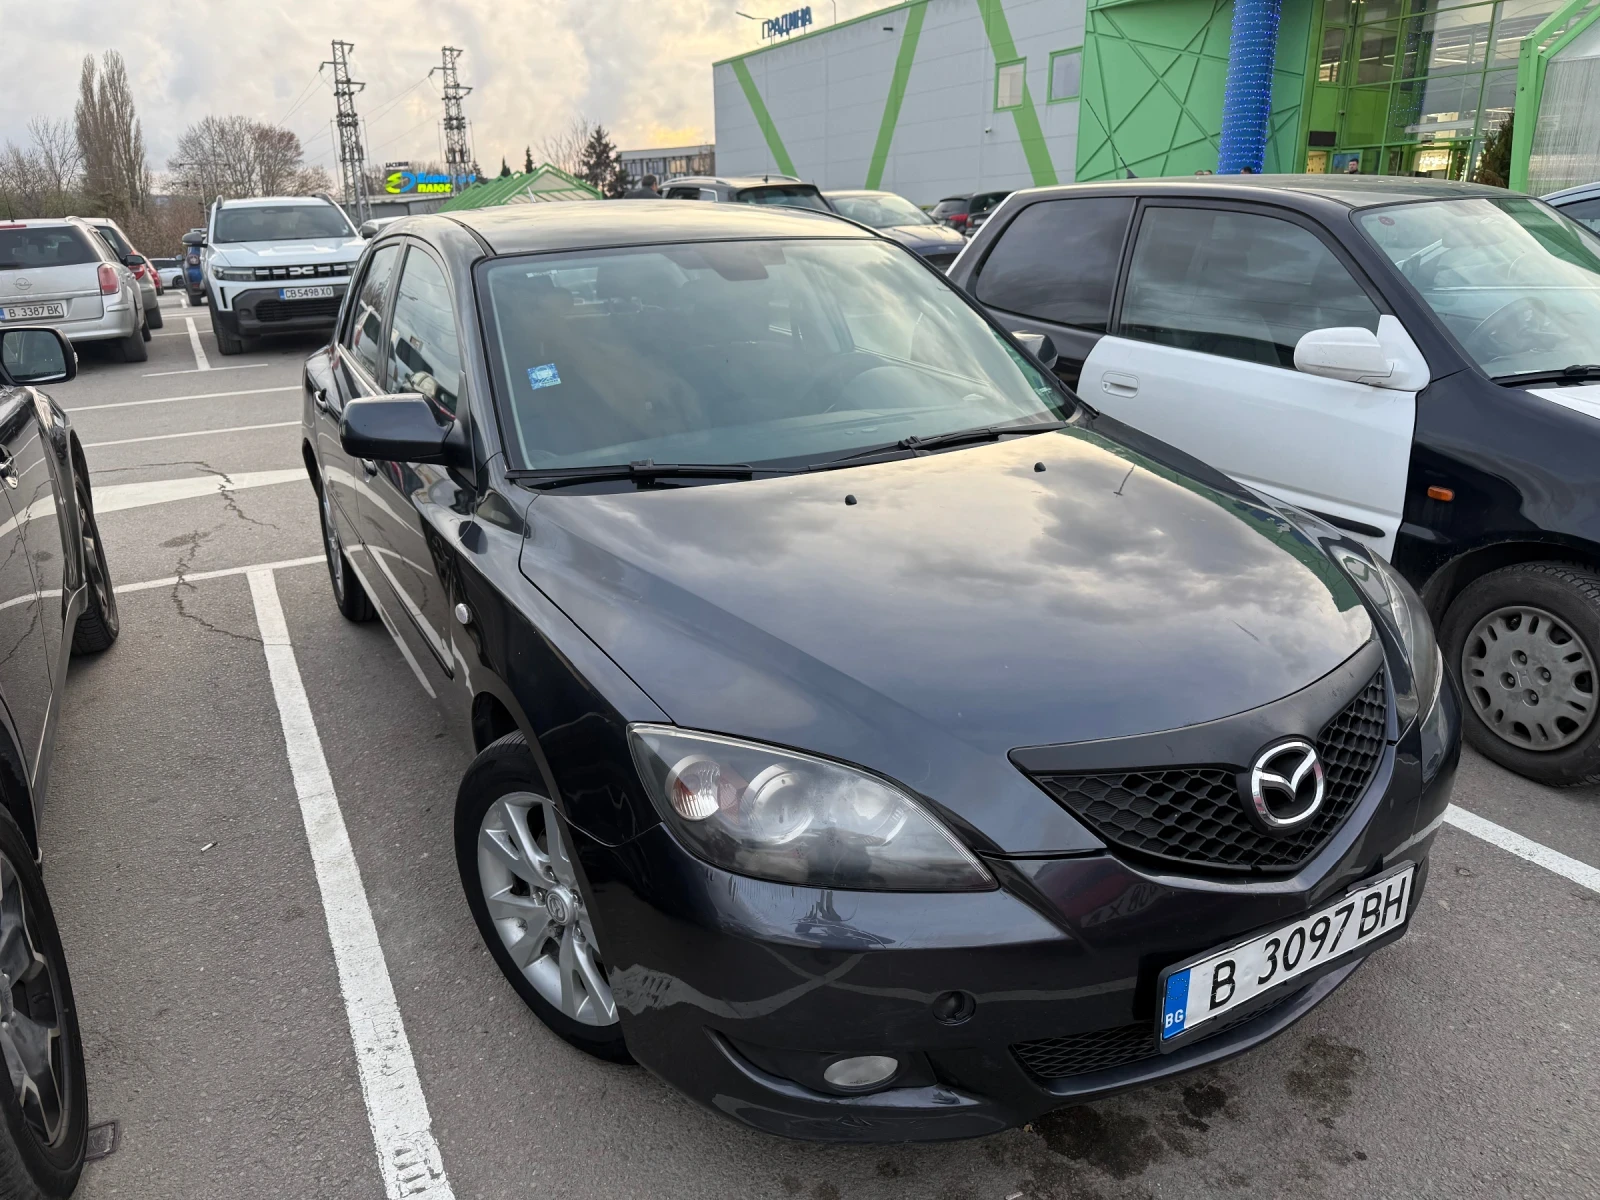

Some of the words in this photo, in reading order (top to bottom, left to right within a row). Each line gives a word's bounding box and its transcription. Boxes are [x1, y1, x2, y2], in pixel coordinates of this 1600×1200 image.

[762, 5, 812, 39] ГРАДИНА
[417, 184, 452, 193] ПЛЮС
[298, 288, 319, 297] 5498
[8, 309, 17, 318] B
[20, 306, 45, 316] 3387
[46, 305, 60, 315] BK
[1209, 959, 1236, 1011] B
[1257, 902, 1355, 985] 3097
[1358, 876, 1407, 940] BH
[1165, 1009, 1184, 1028] BG
